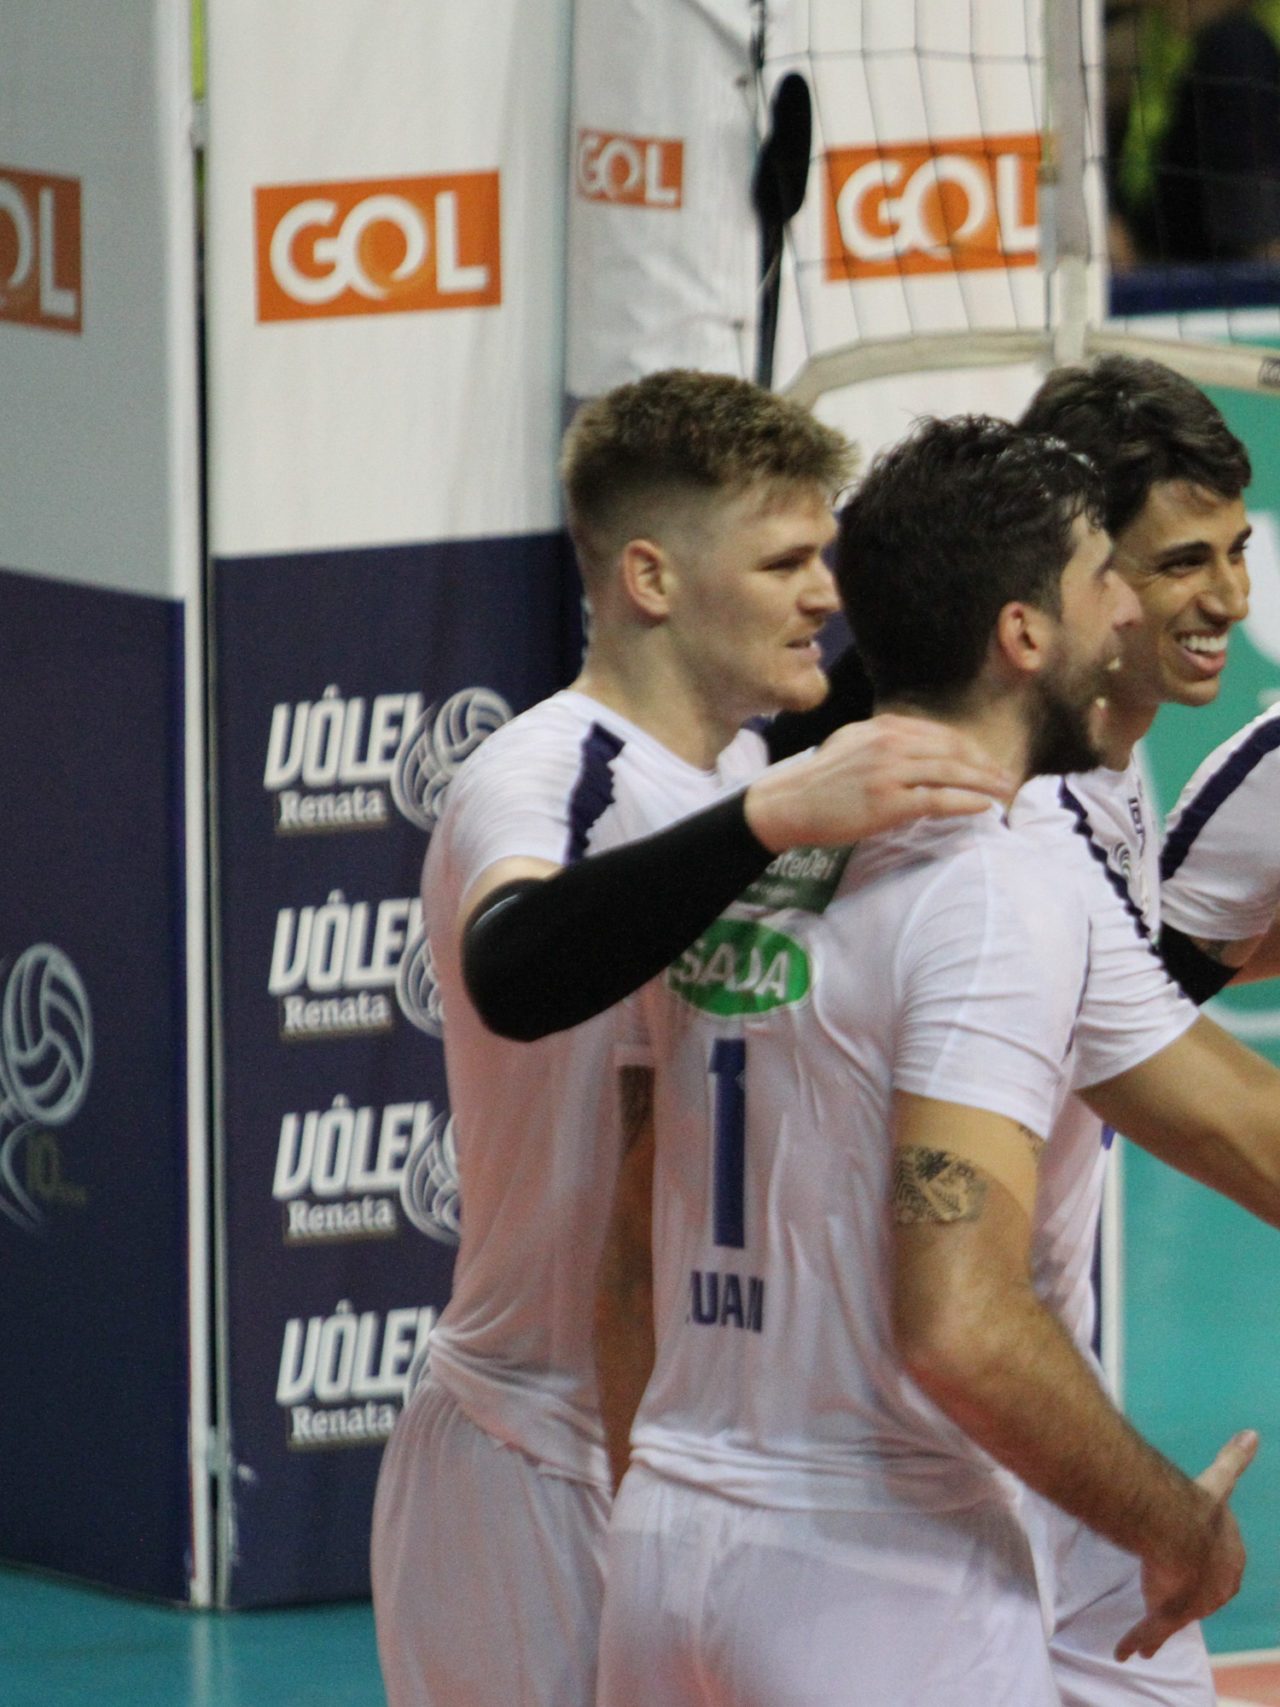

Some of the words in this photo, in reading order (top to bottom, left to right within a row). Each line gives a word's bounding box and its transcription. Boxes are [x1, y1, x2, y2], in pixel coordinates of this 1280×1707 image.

[575, 135, 678, 203] GOL
[835, 153, 1038, 261] GOL
[0, 178, 76, 318] OL
[269, 190, 490, 305] GOL
[278, 786, 389, 828] Renata
[765, 849, 839, 881] aterDei
[283, 990, 393, 1034] Renata
[708, 1038, 747, 1249] 1
[287, 1195, 397, 1239] Renata
[291, 1400, 397, 1444] Renata
